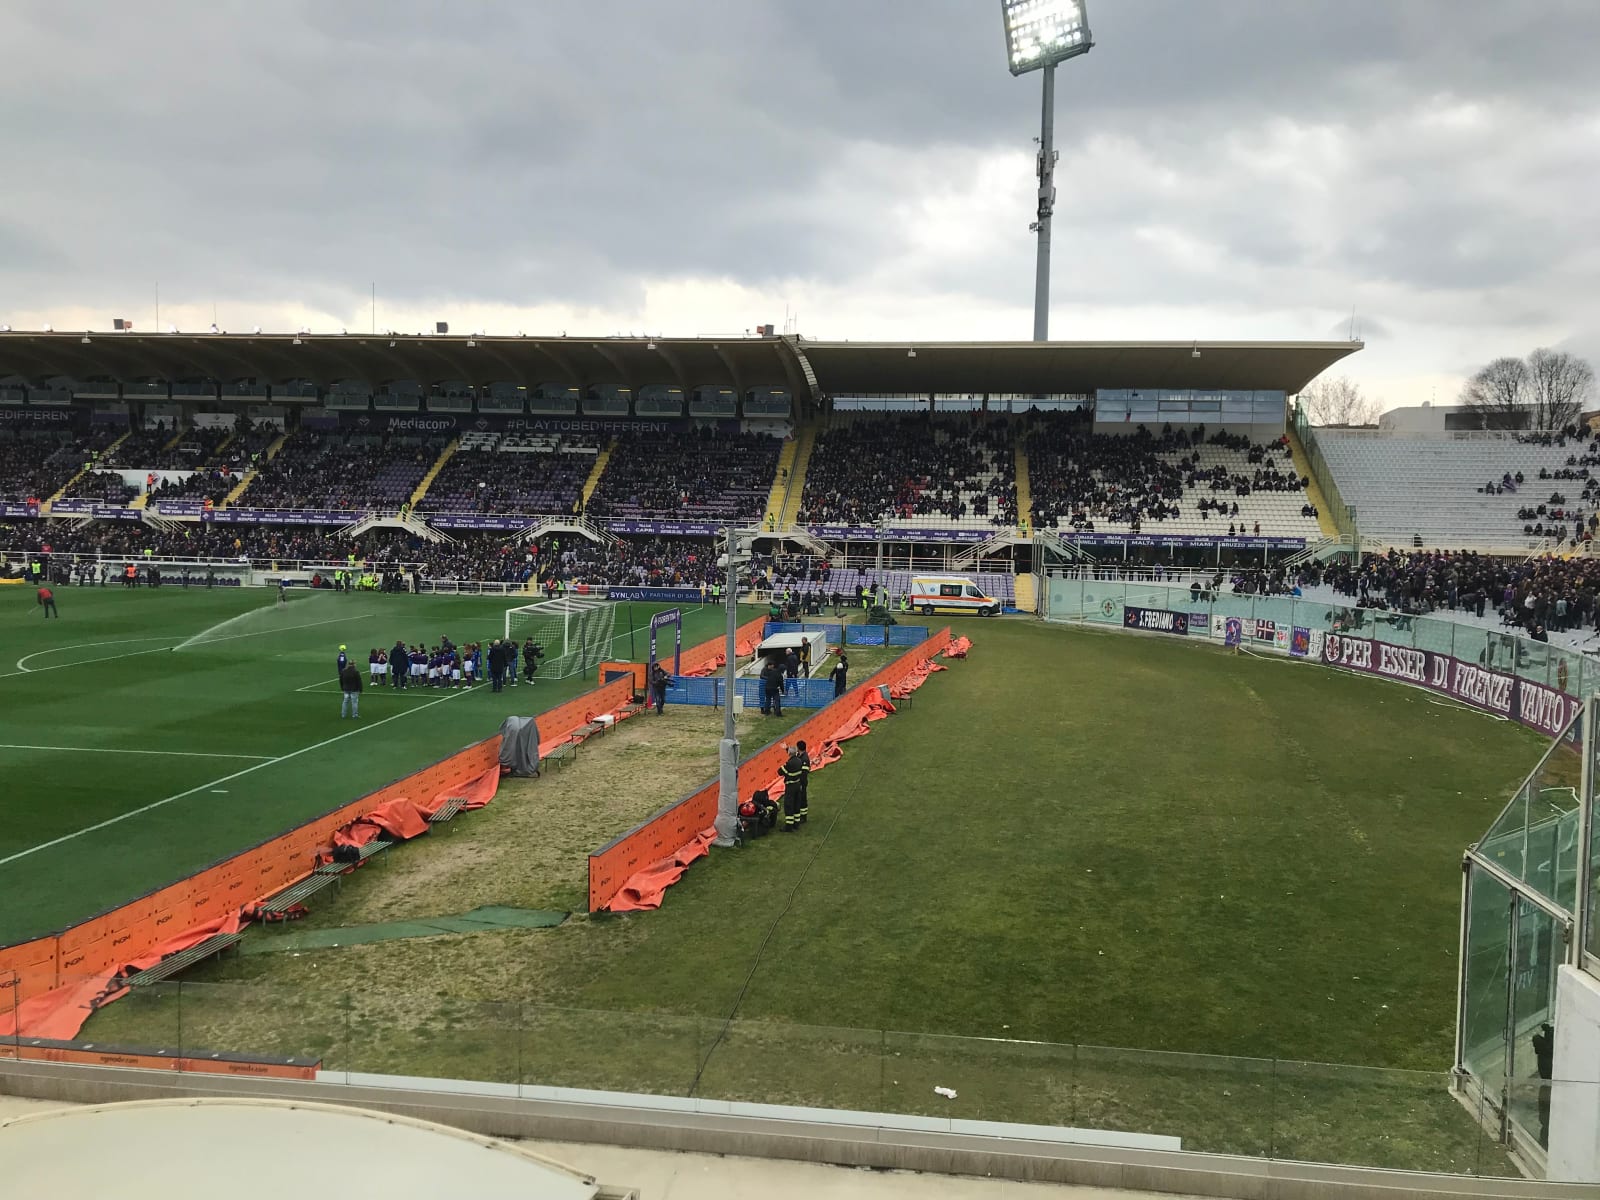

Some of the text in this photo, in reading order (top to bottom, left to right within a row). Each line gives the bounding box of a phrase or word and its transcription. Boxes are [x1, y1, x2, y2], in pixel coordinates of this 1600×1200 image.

[388, 417, 450, 430] Mediacom
[507, 418, 670, 433] #PLAYTOBEDIFFERENT
[610, 591, 640, 599] SYNLAB
[1341, 637, 1372, 669] PER
[1378, 644, 1426, 682] ESSER
[1433, 656, 1450, 689] DI
[1452, 662, 1515, 713] FIRENZE
[1519, 681, 1565, 733] VANTO
